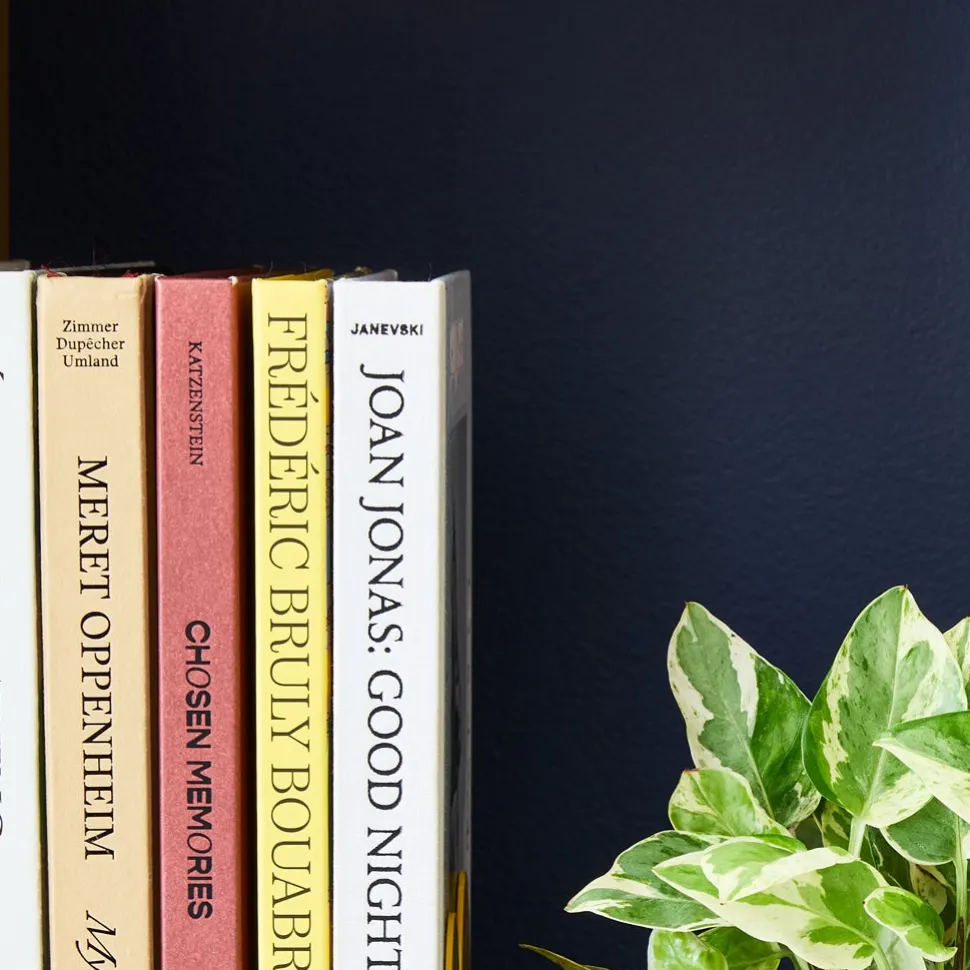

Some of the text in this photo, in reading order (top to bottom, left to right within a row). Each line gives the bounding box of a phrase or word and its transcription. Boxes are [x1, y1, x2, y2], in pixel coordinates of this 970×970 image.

[56, 337, 126, 353] Dupêcher
[62, 319, 119, 333] Zimmer
[63, 354, 119, 368] Umland
[350, 323, 423, 336] JANEVSKI
[188, 340, 204, 467] KATZENSTEIN
[267, 313, 320, 570] FRÉDÉRIC
[359, 363, 405, 488] JOAN
[77, 455, 111, 600] MERET
[358, 496, 404, 654] JONAS:
[80, 611, 115, 860] OPPENHEIM
[269, 585, 310, 753] BRULY
[367, 669, 404, 811] GOOD
[184, 619, 214, 920] CHOSEN MEMORIES
